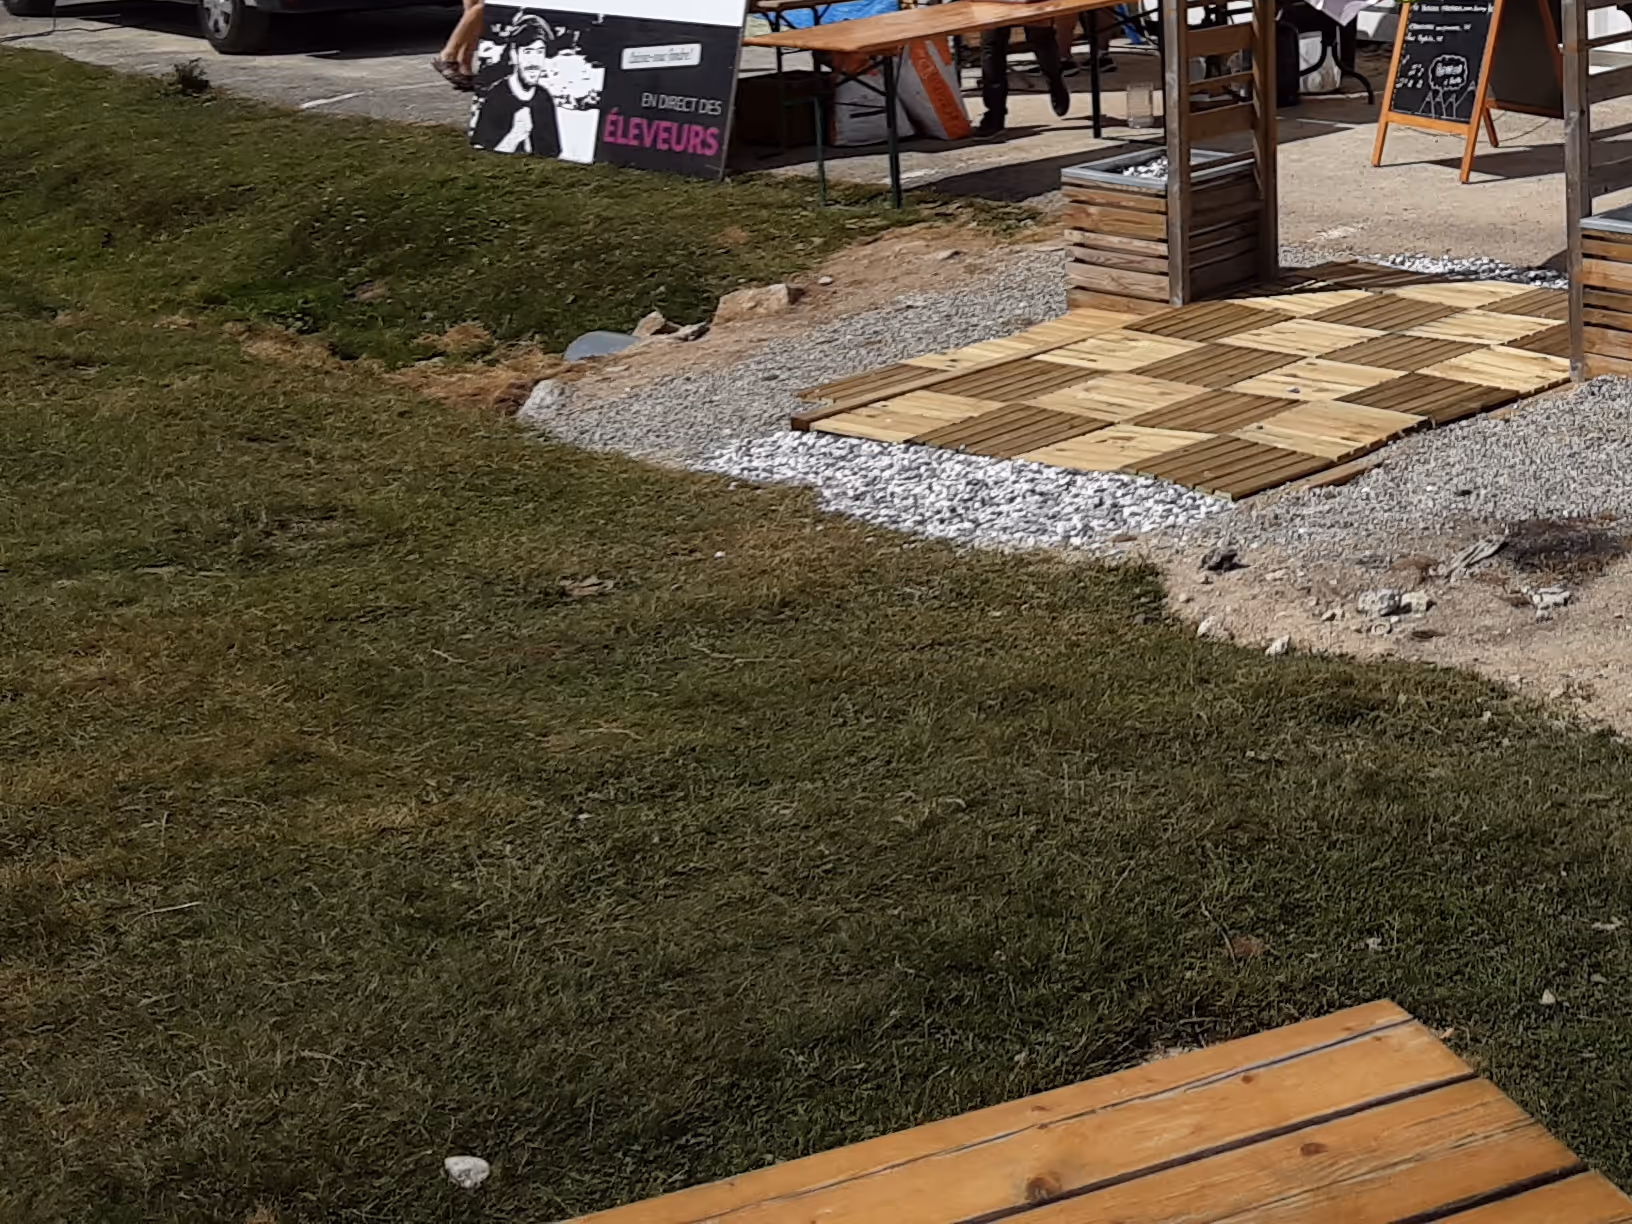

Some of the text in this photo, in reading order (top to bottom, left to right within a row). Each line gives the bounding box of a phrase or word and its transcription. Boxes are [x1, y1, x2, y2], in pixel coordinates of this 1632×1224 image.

[641, 92, 723, 115] EN DIRECT DES
[602, 107, 720, 156] ÉLEVEURS
